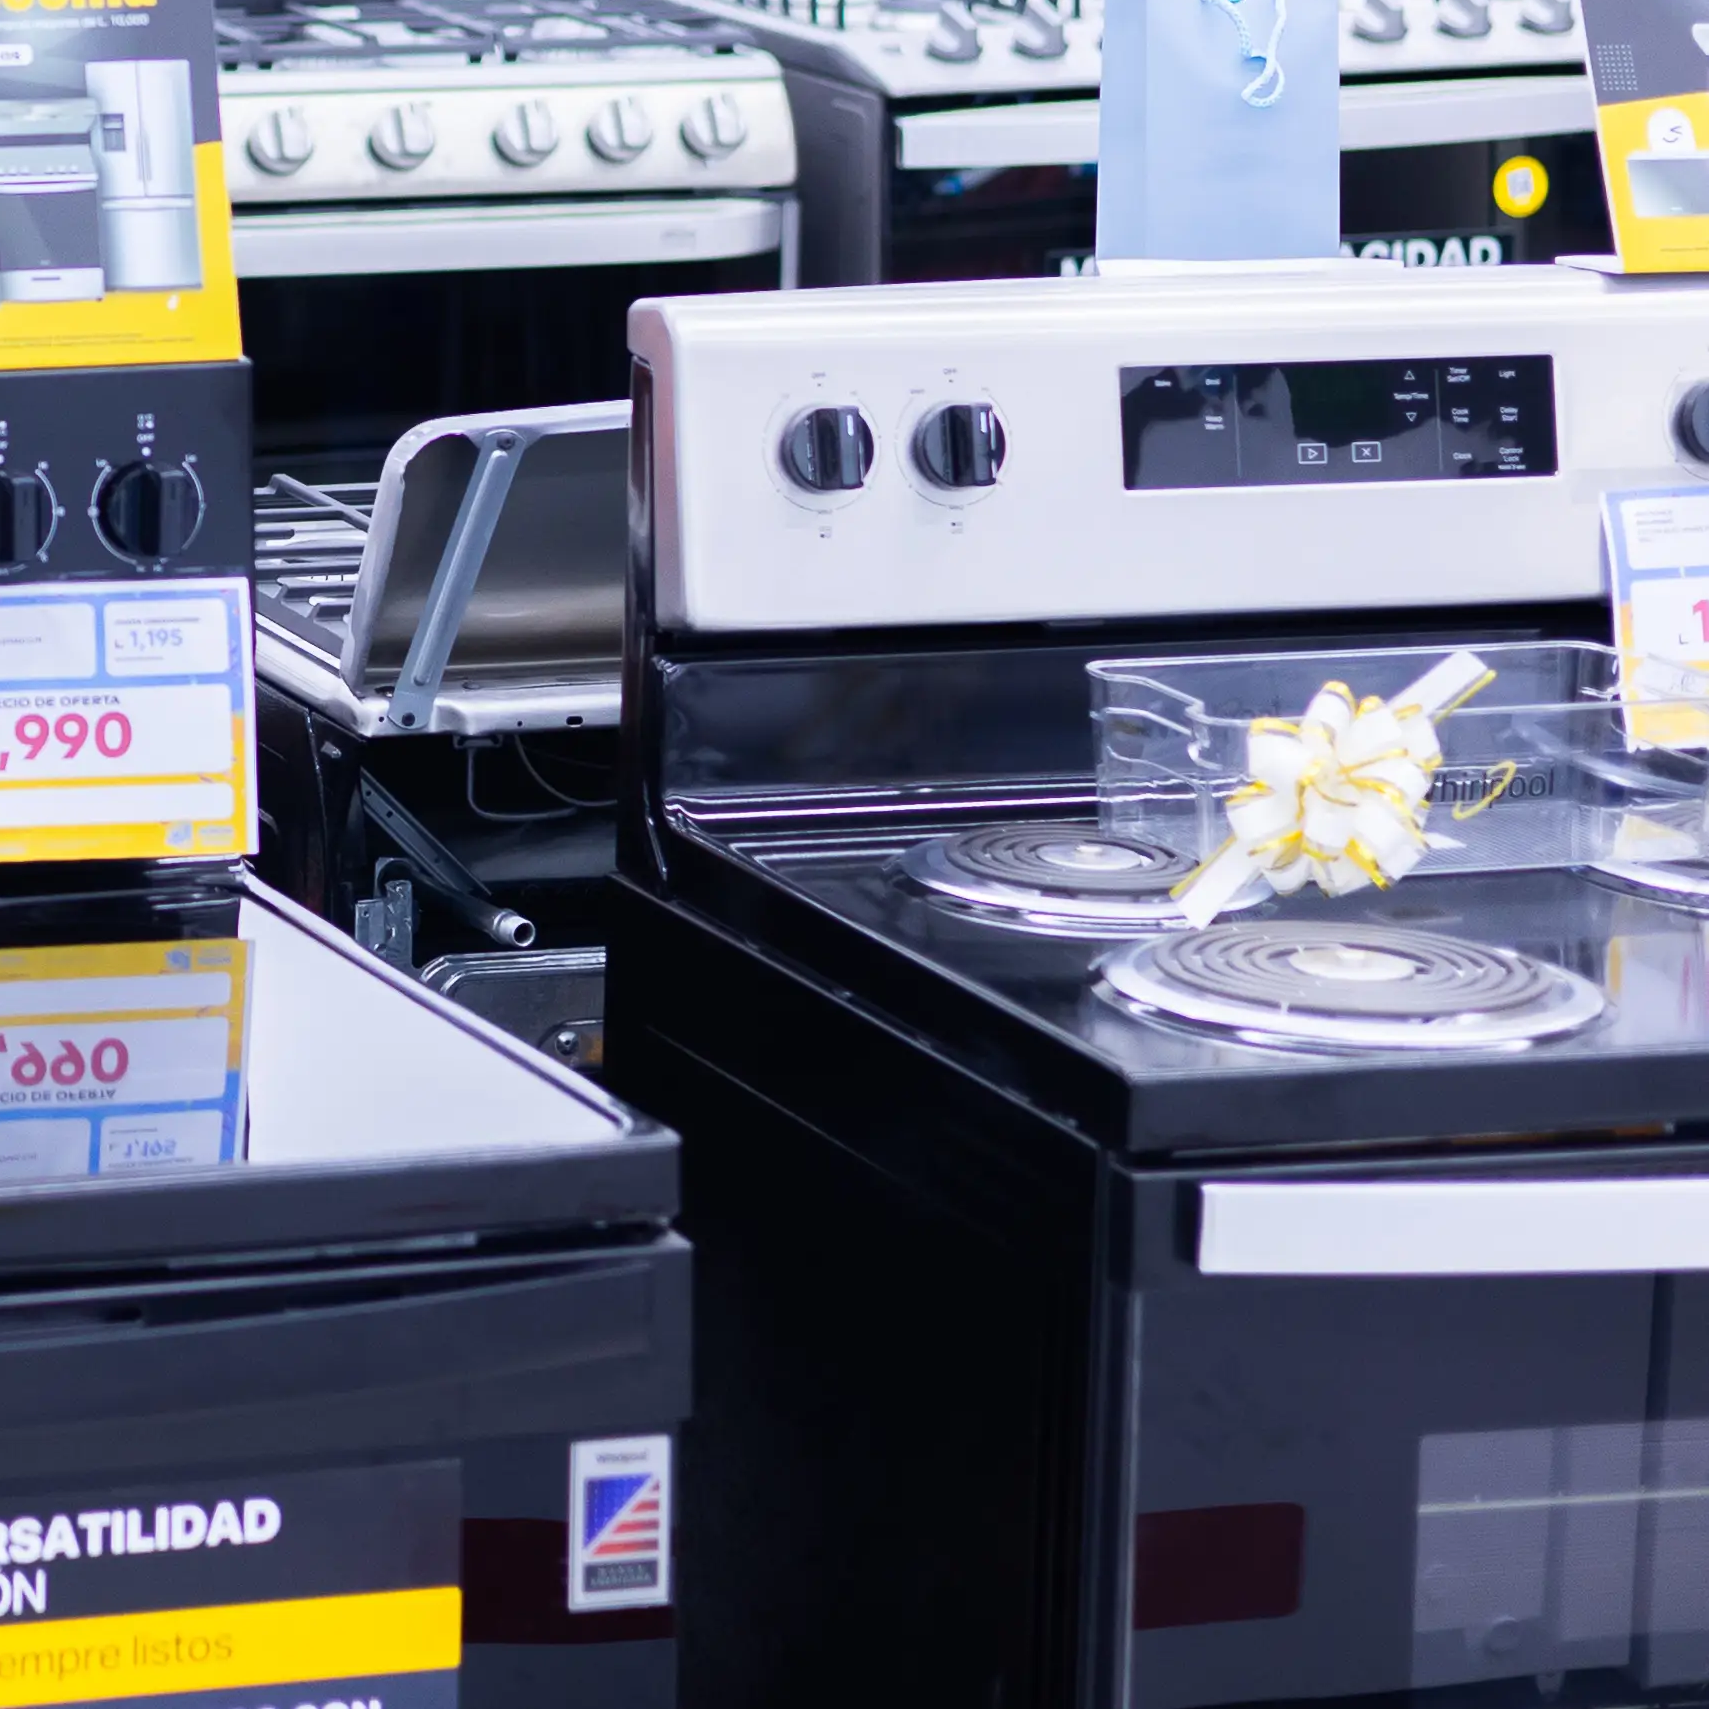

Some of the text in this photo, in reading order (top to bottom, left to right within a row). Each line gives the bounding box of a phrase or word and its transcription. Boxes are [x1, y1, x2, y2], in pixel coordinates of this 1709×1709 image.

[129, 628, 184, 652] 1,195
[35, 696, 55, 708] DE
[60, 694, 121, 707] OFERTA
[132, 1629, 234, 1667] listos
